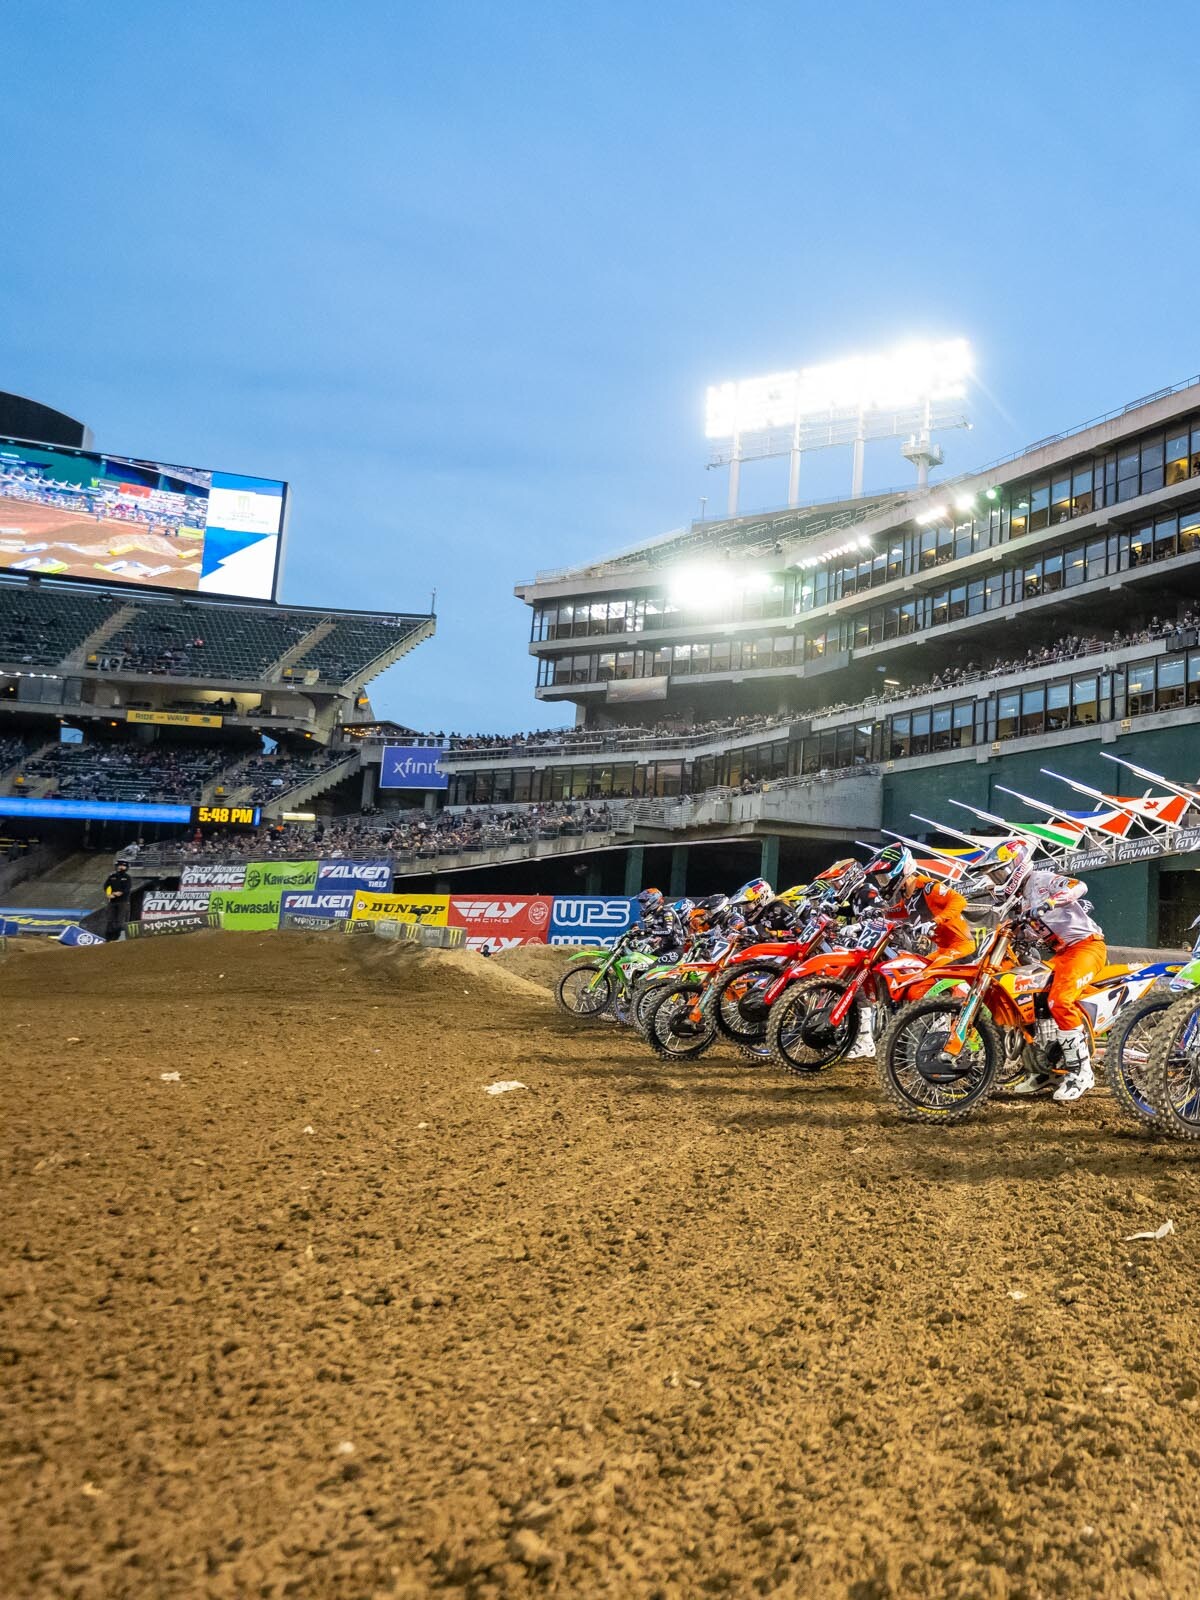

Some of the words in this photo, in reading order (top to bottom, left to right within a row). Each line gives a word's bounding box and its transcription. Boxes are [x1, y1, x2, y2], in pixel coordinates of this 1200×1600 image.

[393, 757, 446, 779] xfinit
[199, 807, 229, 822] 5:48
[231, 809, 253, 823] PM
[264, 871, 316, 886] Kawasaki
[319, 865, 391, 879] FALKEN
[226, 901, 279, 914] Kawasaki
[285, 894, 353, 909] FALKEN
[452, 901, 527, 918] FLY
[553, 900, 631, 927] WPS
[144, 917, 202, 931] MONSTER
[860, 929, 877, 949] 23
[712, 941, 728, 959] 7
[1076, 972, 1094, 989] THOR
